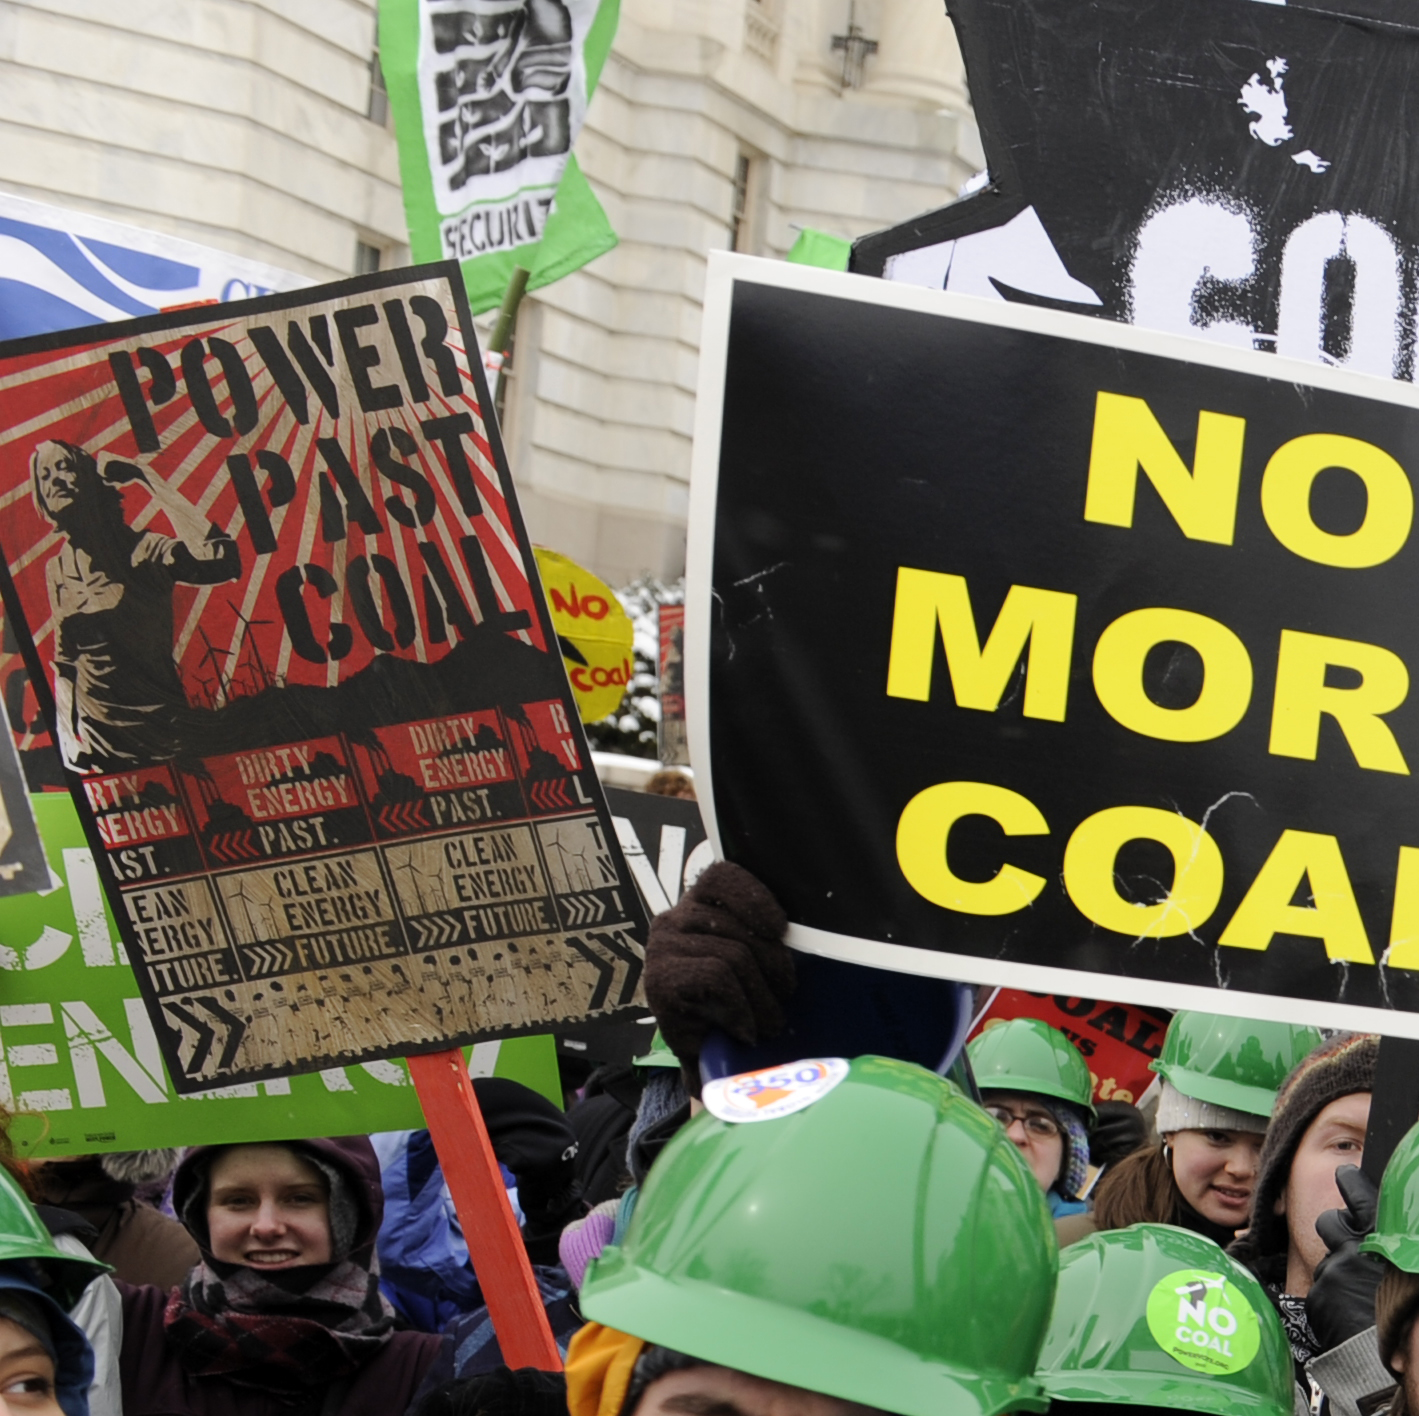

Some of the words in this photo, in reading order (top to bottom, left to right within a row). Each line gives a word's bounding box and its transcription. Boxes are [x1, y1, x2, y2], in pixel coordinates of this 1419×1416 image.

[108, 295, 463, 453] POWER
[226, 412, 484, 554] PAST
[1083, 390, 1414, 568] NO
[275, 536, 533, 664] COAL
[550, 582, 609, 621] NO
[408, 717, 477, 755] DIRTY
[235, 746, 312, 786] DIRTY
[419, 747, 508, 788] ENERGY
[245, 774, 350, 818] ENERGY
[429, 789, 502, 826] PAST.
[258, 817, 339, 855] PAST.
[443, 833, 518, 869] CLEAN
[273, 860, 358, 899] CLEAN
[453, 864, 540, 902] ENERGY
[282, 889, 388, 932] ENERGY
[462, 901, 557, 939] FUTURE.
[295, 925, 404, 968] FUTURE.
[1177, 1297, 1237, 1336] NO
[1175, 1326, 1233, 1358] COAL
